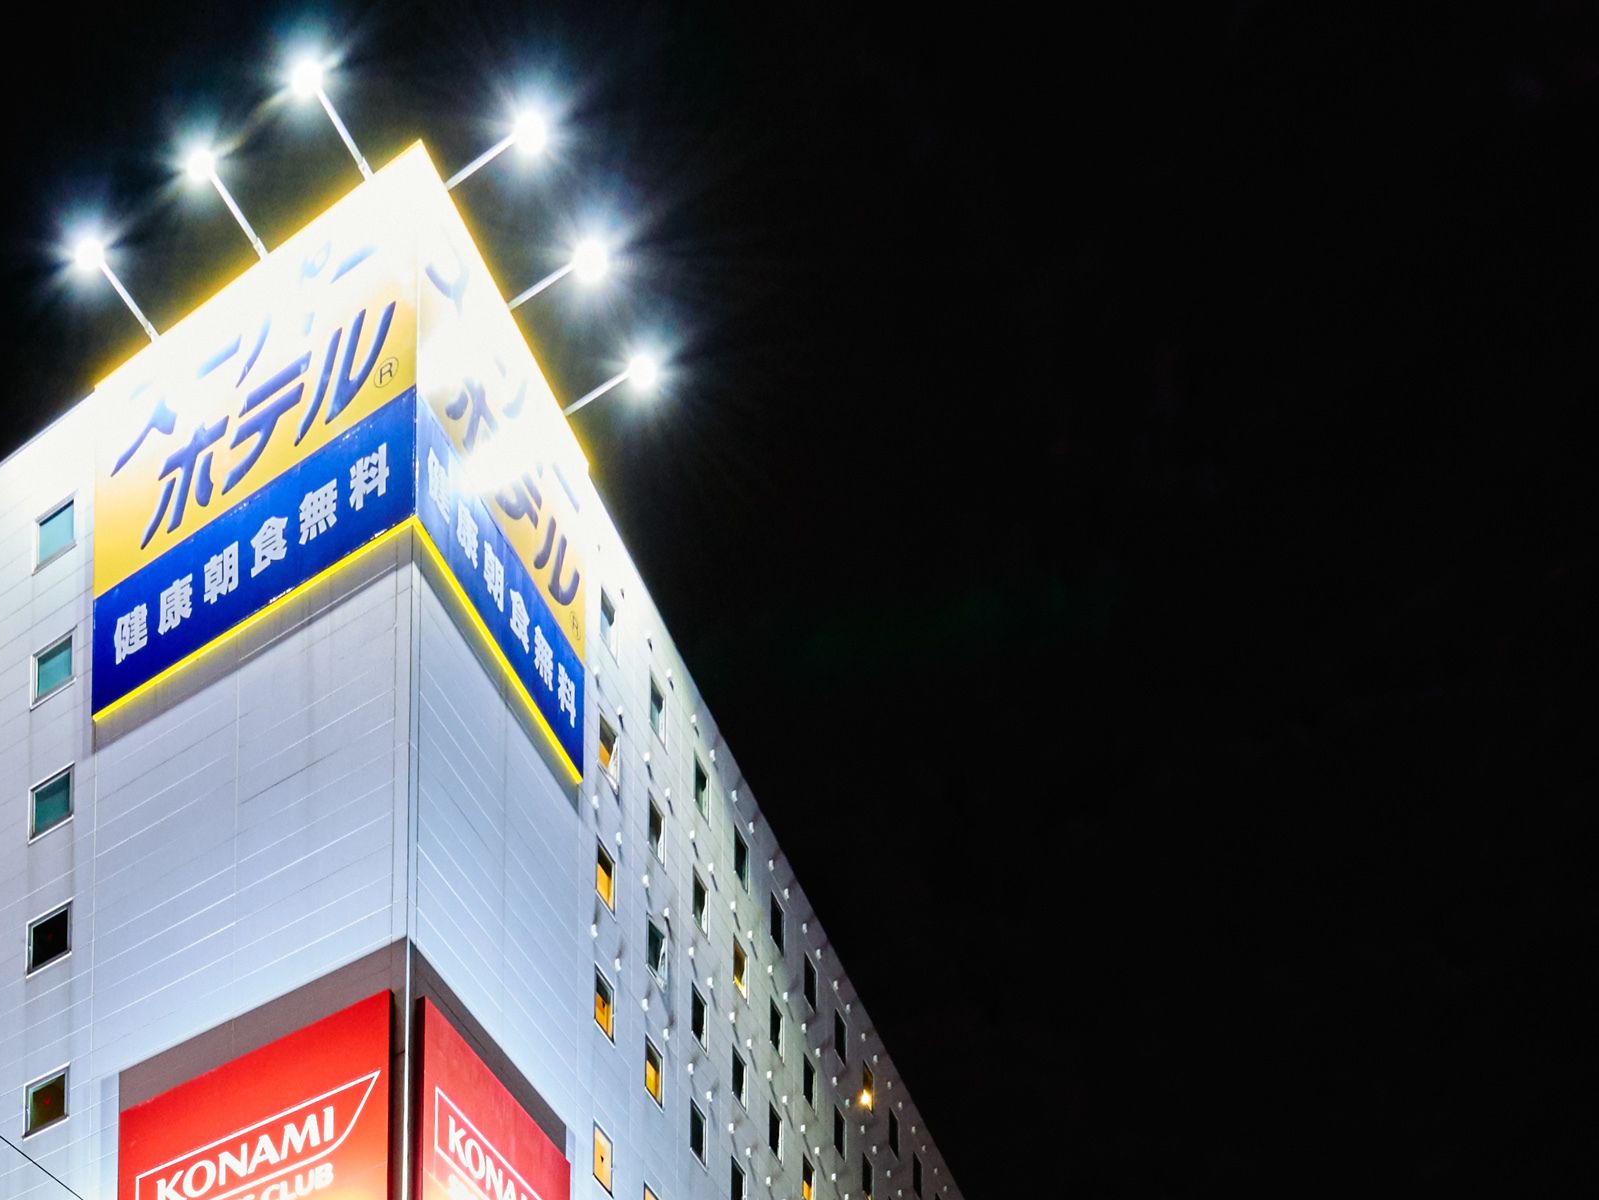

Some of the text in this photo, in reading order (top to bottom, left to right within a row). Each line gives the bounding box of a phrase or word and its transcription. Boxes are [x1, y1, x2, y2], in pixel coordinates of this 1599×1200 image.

[141, 301, 397, 550] ホテル
[113, 443, 389, 665] 健康朝食無料
[427, 447, 577, 729] 健康朝食無料
